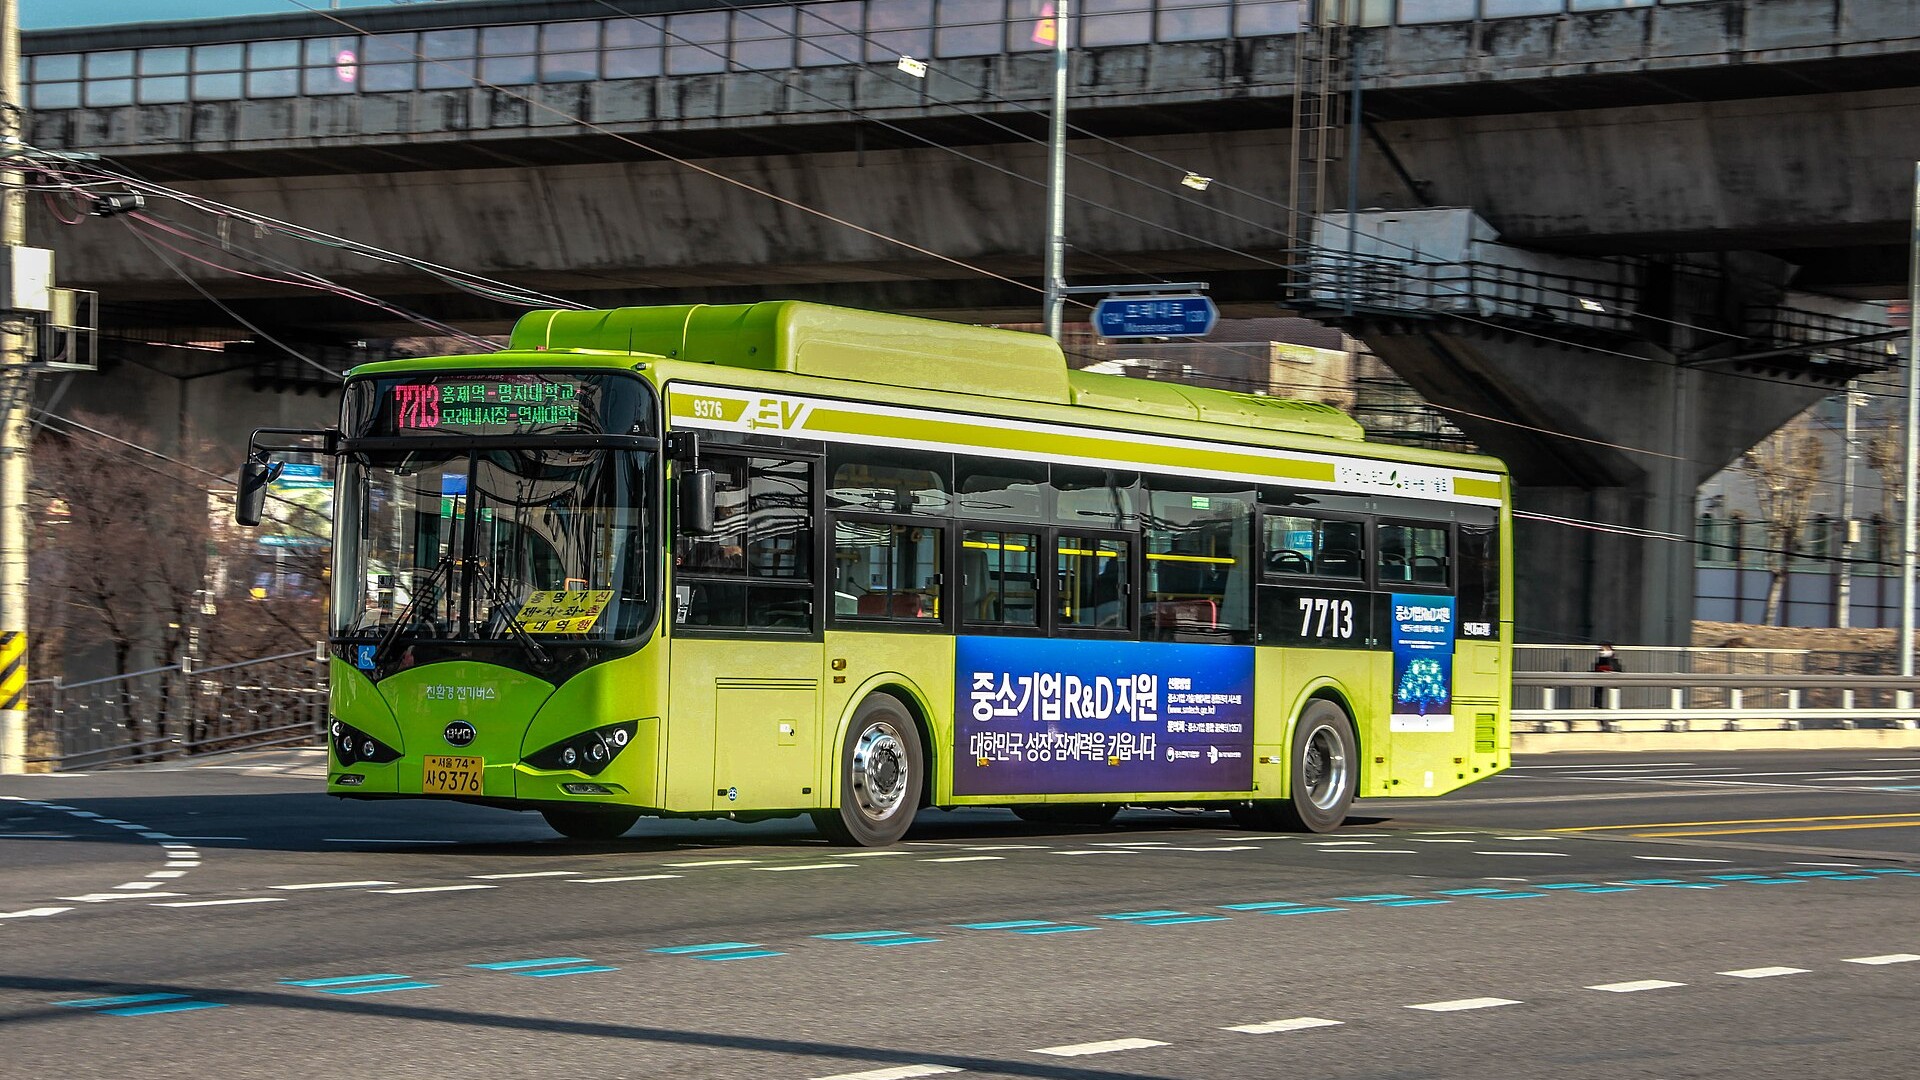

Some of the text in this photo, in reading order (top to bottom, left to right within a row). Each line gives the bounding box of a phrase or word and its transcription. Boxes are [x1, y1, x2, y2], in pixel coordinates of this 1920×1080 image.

[395, 385, 440, 428] 7713
[693, 400, 723, 418] 9376
[750, 398, 804, 430] EV
[1299, 597, 1354, 639] 7713
[426, 684, 495, 700] 친환경 전기버스
[970, 672, 1158, 722] 중소기업 R&D 지원
[446, 728, 471, 740] BYD
[970, 731, 1157, 762] 대한민국 성장 잠재력을 키웁니다
[438, 758, 469, 769] 서울 74
